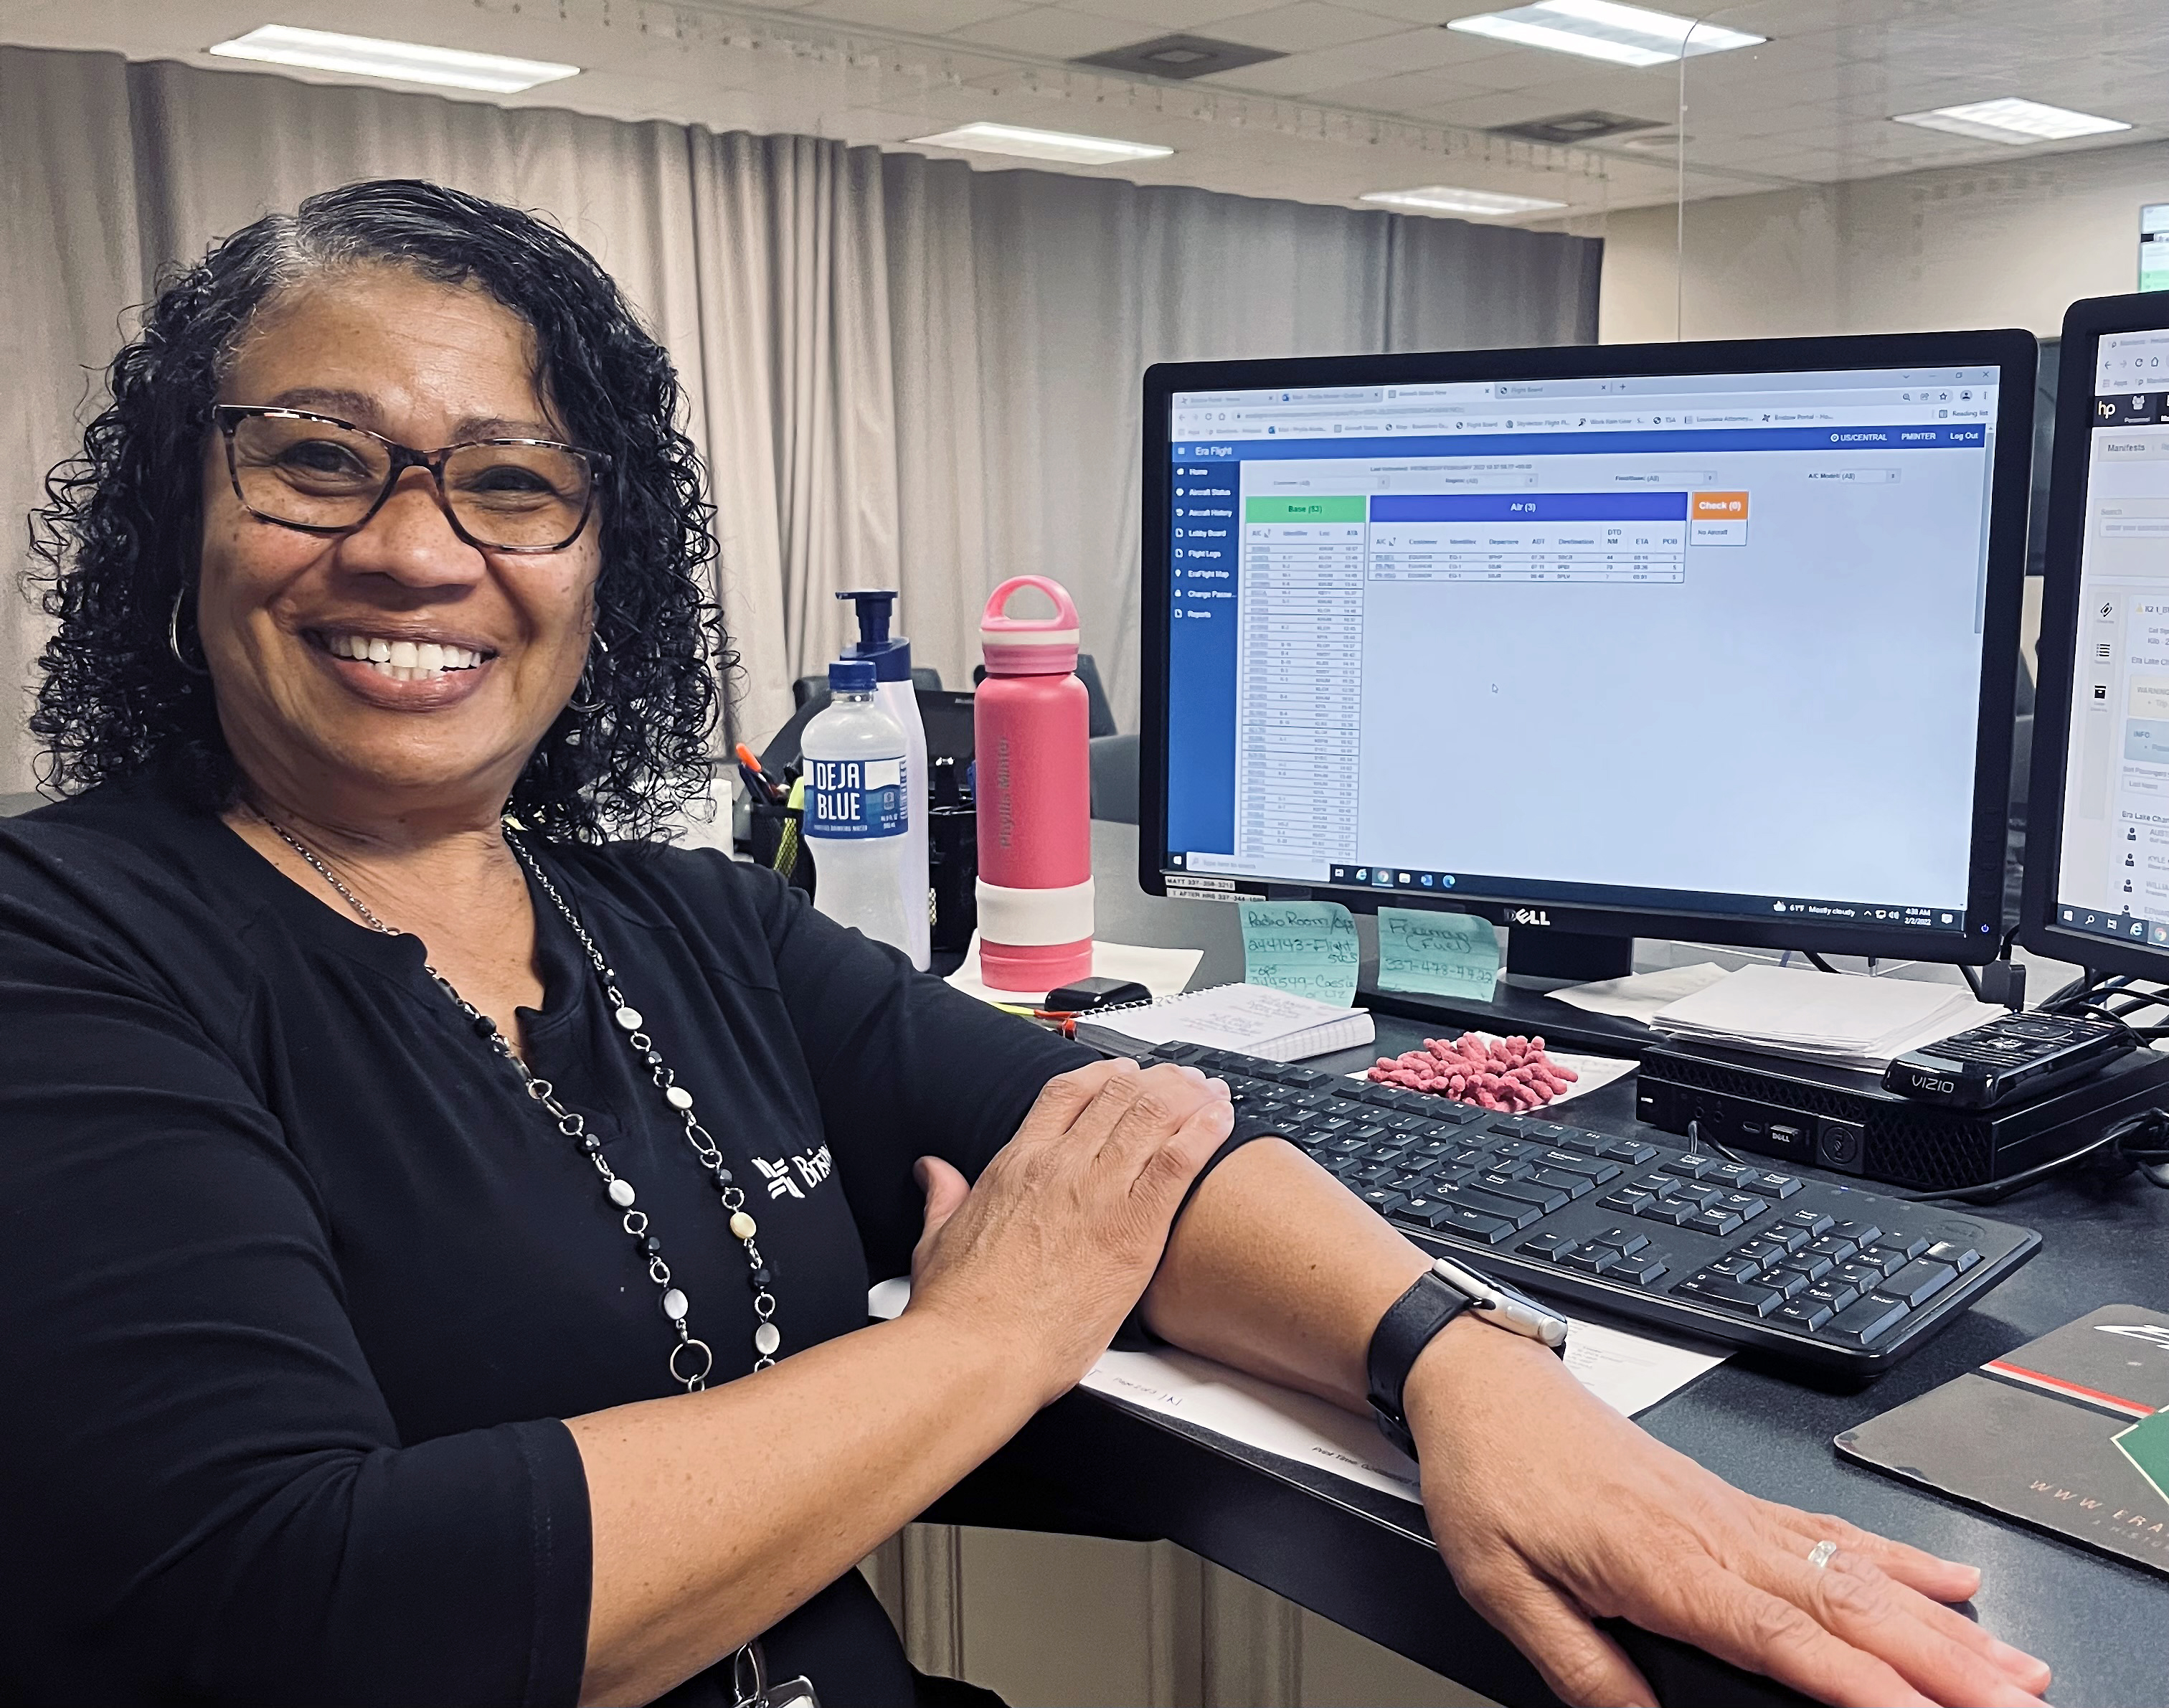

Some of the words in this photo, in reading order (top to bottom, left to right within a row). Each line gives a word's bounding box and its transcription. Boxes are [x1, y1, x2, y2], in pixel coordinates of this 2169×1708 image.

[2098, 400, 2116, 419] hp
[1195, 446, 1209, 456] Era
[1210, 446, 1232, 456] Flight
[817, 763, 860, 791] DEJA
[817, 792, 861, 820] BLUE
[2135, 812, 2150, 821] Lake
[1504, 908, 1550, 925] DELL
[1912, 1075, 1955, 1093] VIZIO
